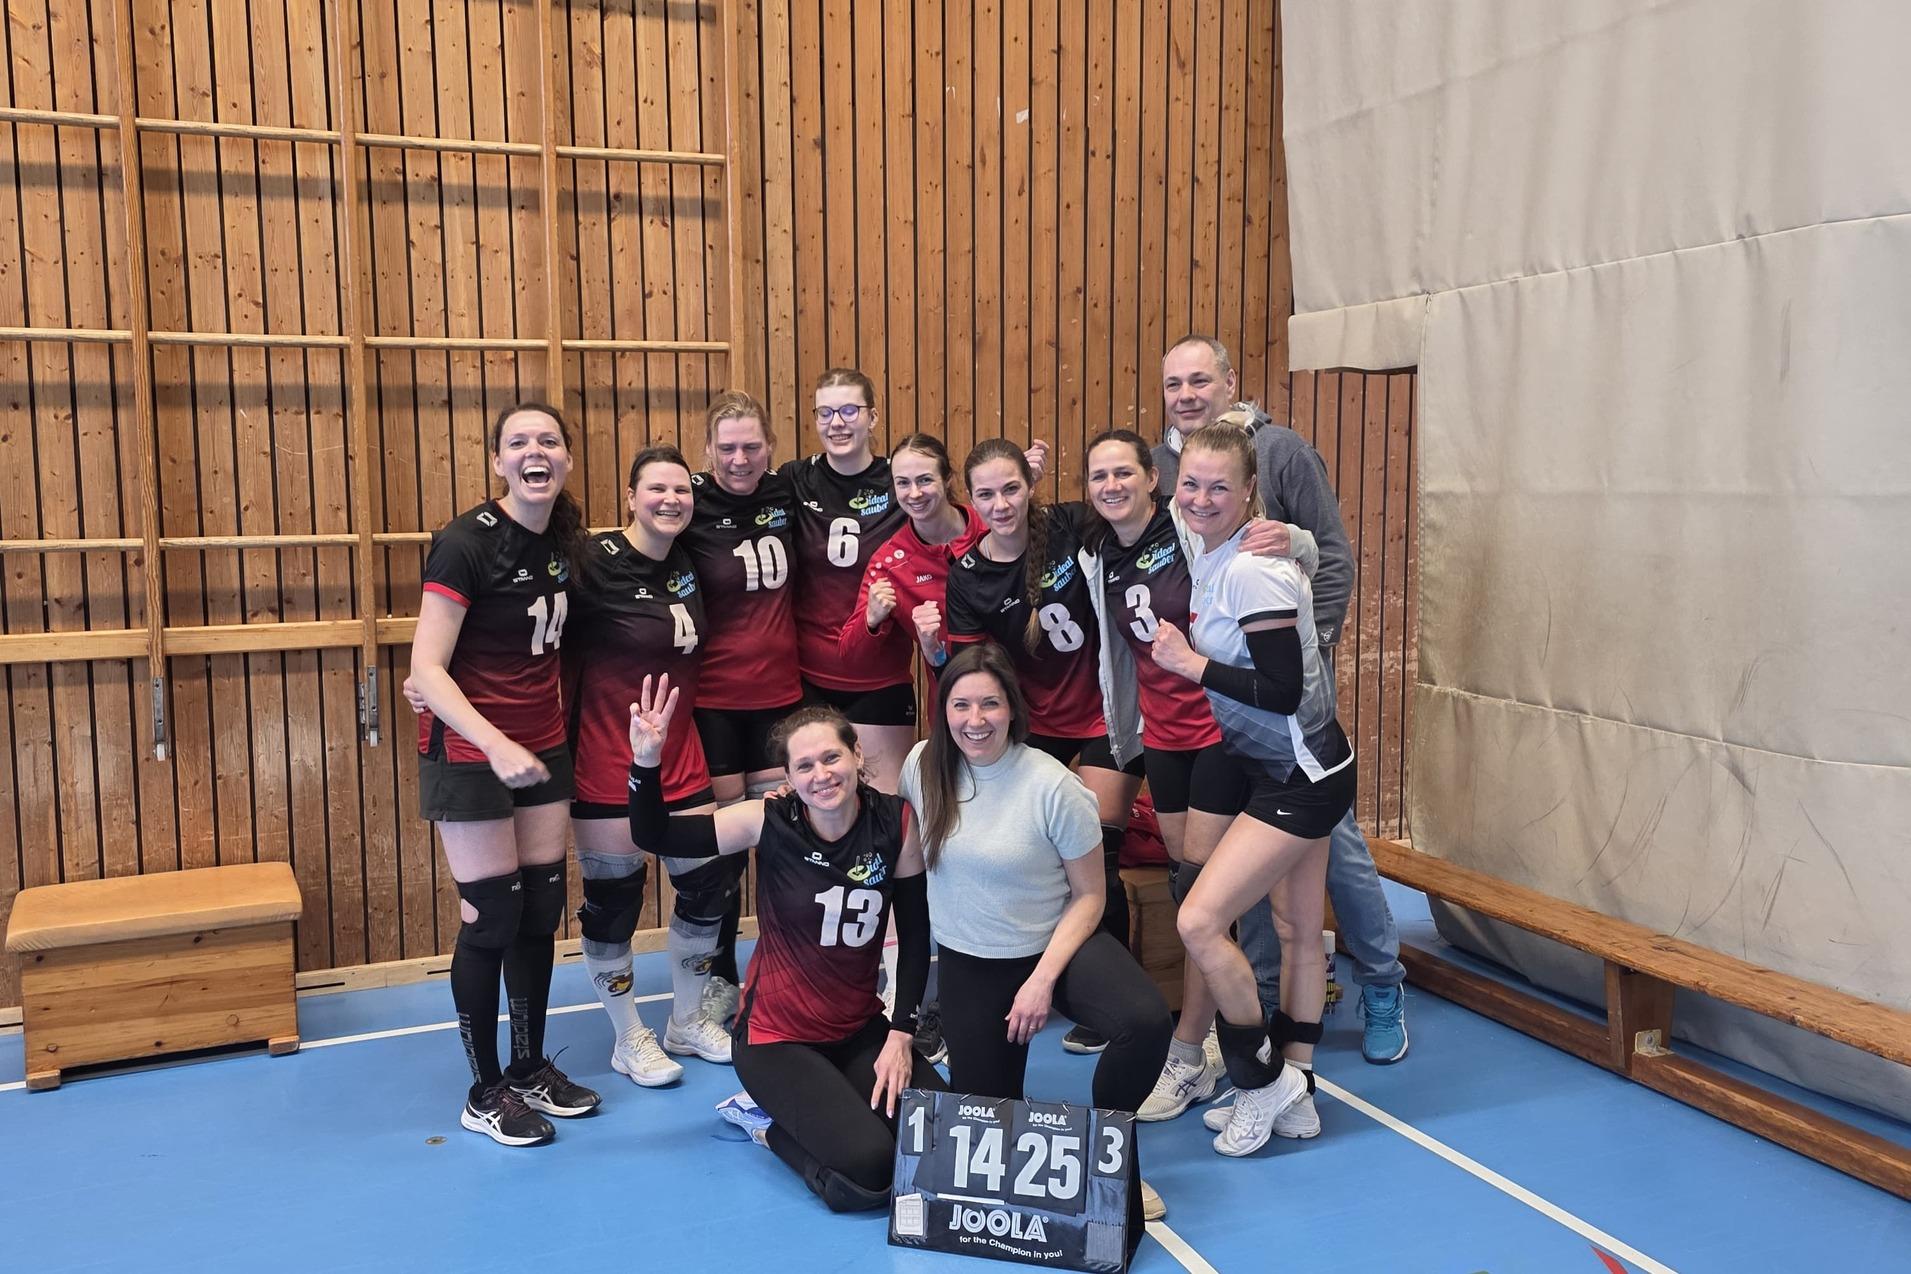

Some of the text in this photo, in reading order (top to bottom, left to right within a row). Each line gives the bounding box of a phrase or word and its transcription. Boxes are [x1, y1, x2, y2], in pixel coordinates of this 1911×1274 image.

[860, 502, 889, 516] sauber
[868, 492, 889, 505] ideal
[733, 535, 789, 592] 10
[827, 517, 861, 568] 6
[1054, 555, 1075, 577] ideal
[1148, 553, 1176, 575] sauber
[1153, 542, 1176, 561] ideal
[916, 574, 933, 584] JAKO
[527, 591, 569, 656] 14
[669, 603, 699, 655] 4
[1038, 602, 1085, 653] 8
[1125, 584, 1160, 643] 3
[814, 885, 884, 948] 13
[908, 1106, 1125, 1200] 1 14 25 3
[973, 1236, 987, 1245] the
[988, 1239, 1032, 1258] Champion
[1033, 1250, 1042, 1259] in
[1043, 1249, 1063, 1260] you!
